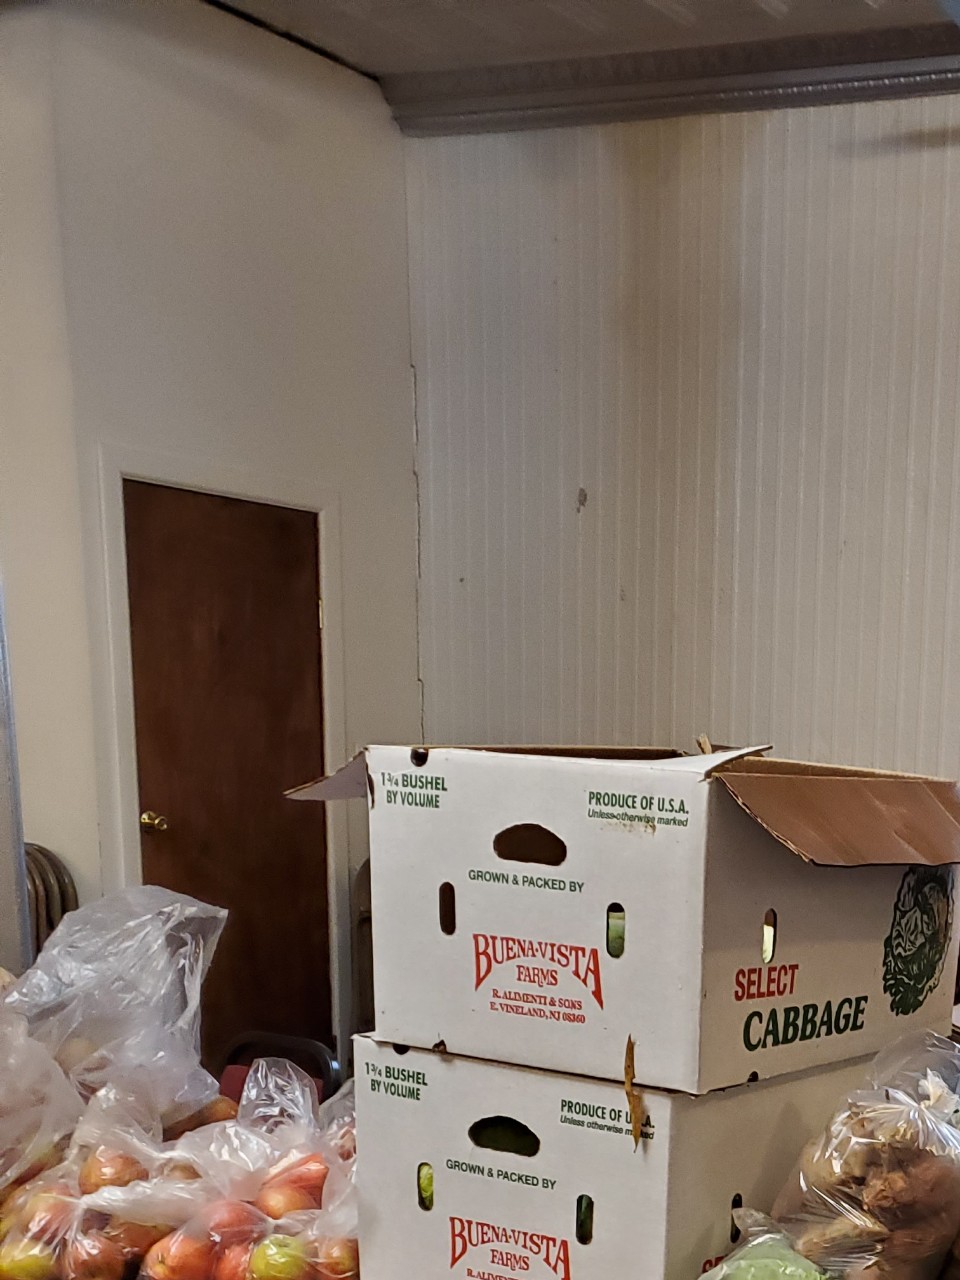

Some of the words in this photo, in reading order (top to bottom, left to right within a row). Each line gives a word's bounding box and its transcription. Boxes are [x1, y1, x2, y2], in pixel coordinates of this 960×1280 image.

[402, 773, 448, 791] BUSHEL
[386, 790, 398, 804] BY
[400, 791, 440, 808] VOLUME
[588, 791, 637, 809] PRODUCE
[640, 795, 655, 811] OF
[657, 797, 689, 814] U.S.A.
[587, 808, 614, 819] Unless
[616, 812, 656, 824] otherwise
[657, 816, 689, 827] marked
[468, 869, 509, 885] GROWN
[512, 874, 519, 886] &
[522, 875, 566, 891] PACKED
[569, 881, 584, 893] BY
[516, 964, 558, 987] FARMS
[734, 963, 799, 1002] SELECT
[499, 1003, 548, 1020] VINELAND,
[549, 1010, 560, 1021] NJ
[562, 1014, 586, 1024] 08360
[549, 997, 556, 1007] &
[558, 998, 582, 1011] SONS
[743, 995, 869, 1052] CABBAGE
[385, 1065, 428, 1086] BUSHEL
[371, 1078, 381, 1093] BY
[383, 1081, 421, 1101] VOLUME
[561, 1099, 607, 1120] PRODUCE
[609, 1108, 622, 1123] OF
[560, 1115, 585, 1127] Unless
[586, 1121, 623, 1134] otherwise
[446, 1159, 485, 1176] GROWN
[487, 1167, 494, 1178] &
[497, 1169, 539, 1187] PACKED
[541, 1178, 556, 1190] BY
[490, 1249, 530, 1271] FARMS
